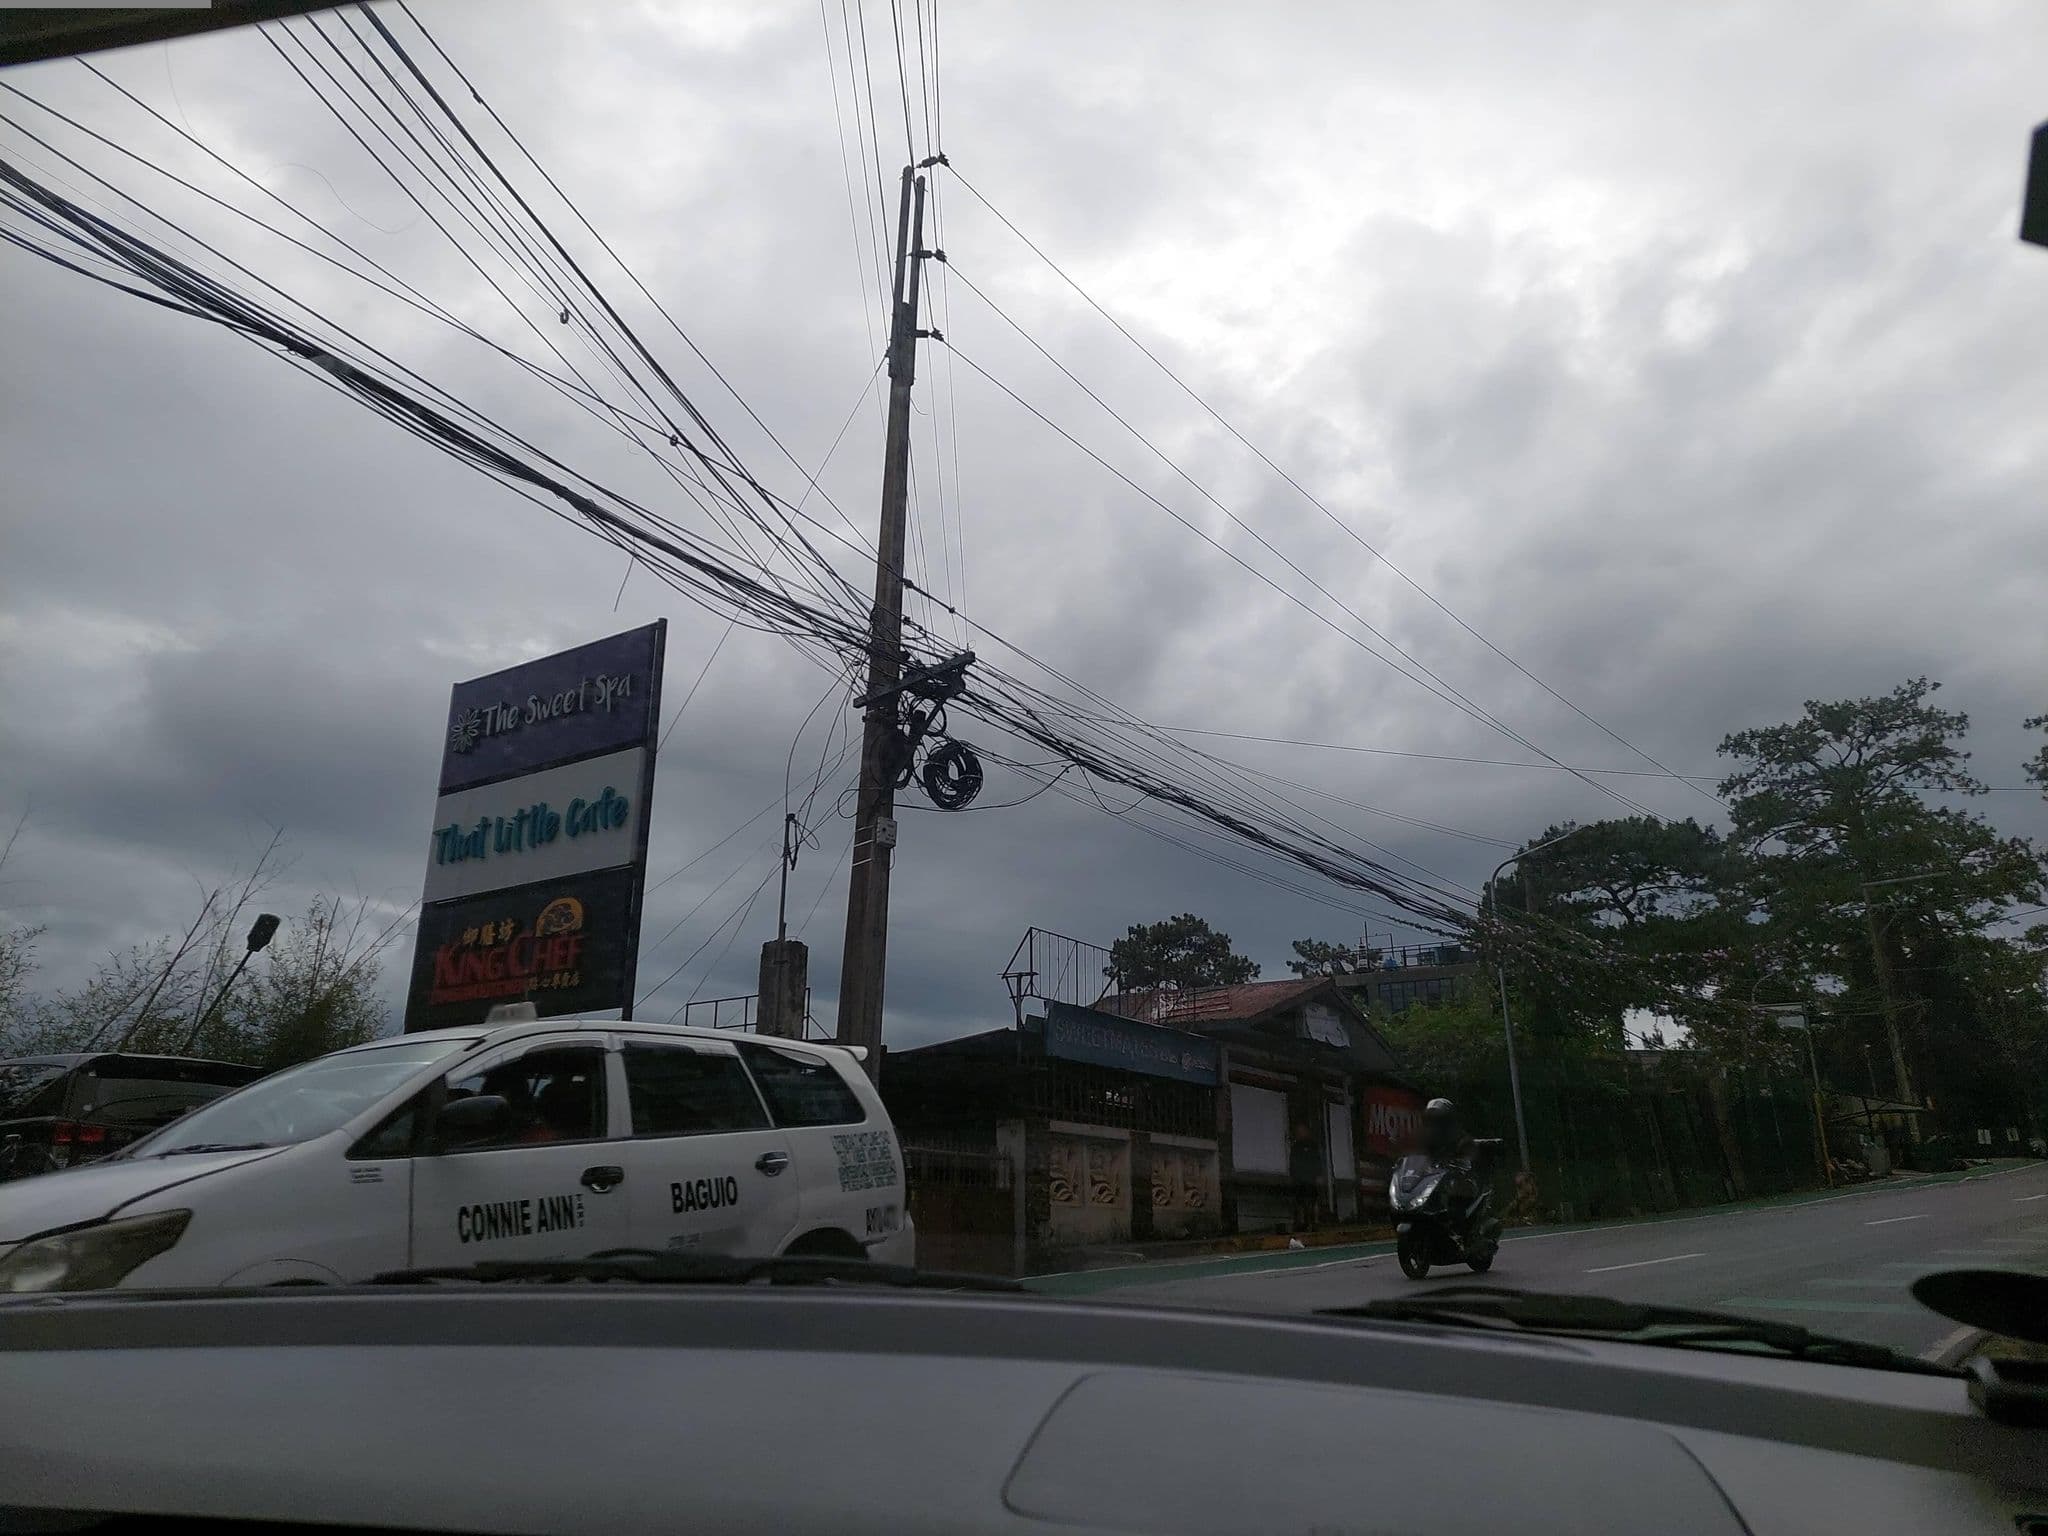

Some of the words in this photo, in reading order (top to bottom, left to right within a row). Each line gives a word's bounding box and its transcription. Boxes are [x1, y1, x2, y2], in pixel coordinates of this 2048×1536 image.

[481, 700, 519, 737] The
[524, 676, 589, 725] Sweet
[594, 672, 632, 713] Spa
[433, 815, 491, 866] That
[493, 801, 560, 854] Little
[565, 785, 630, 838] Cafe
[457, 1200, 531, 1244] CONNIE
[537, 1195, 575, 1233] ANN
[670, 1176, 738, 1214] BAGUIO
